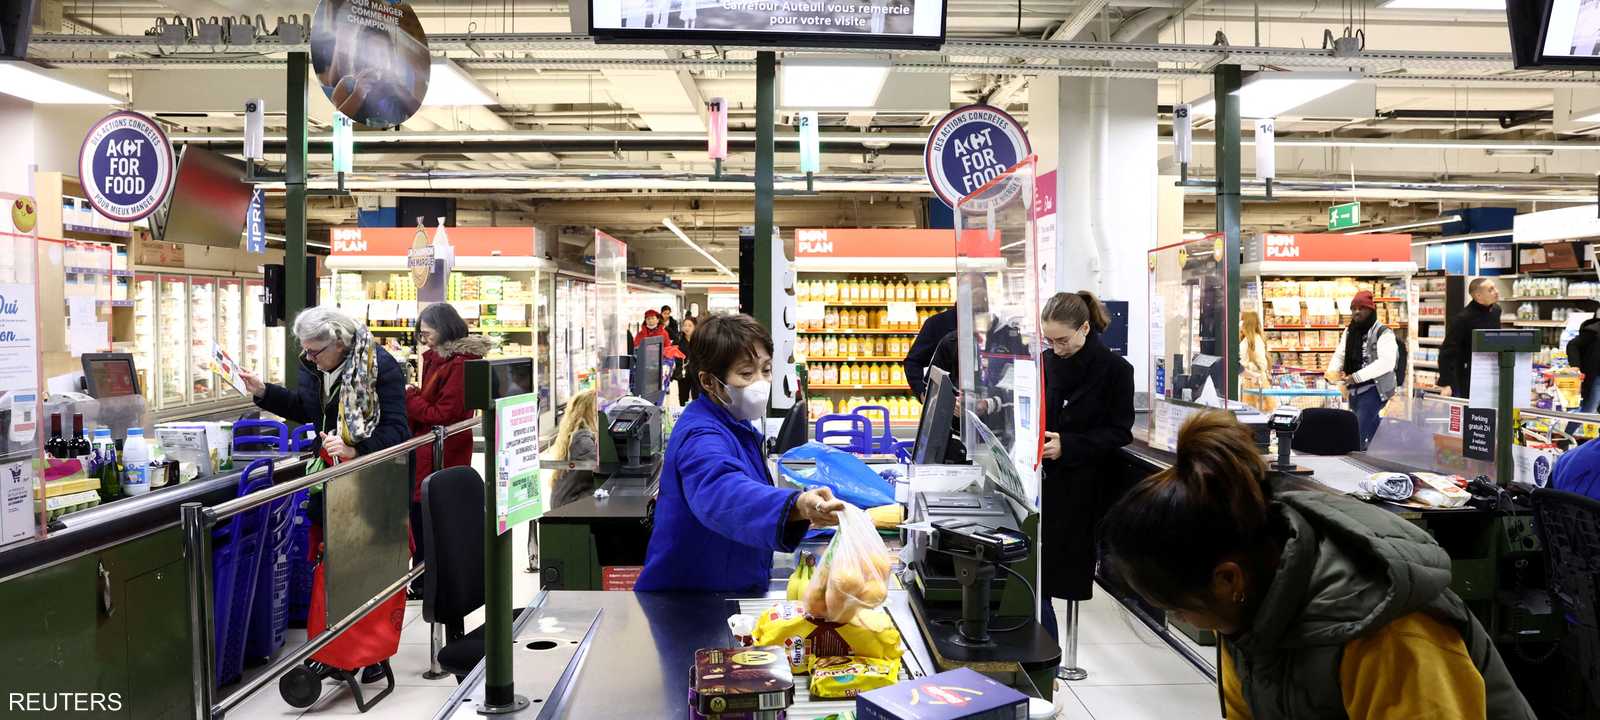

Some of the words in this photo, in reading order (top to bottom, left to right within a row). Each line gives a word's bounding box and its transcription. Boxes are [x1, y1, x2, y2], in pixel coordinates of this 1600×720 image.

[351, 5, 383, 20] COMME
[371, 1, 404, 17] MANGER
[722, 0, 778, 10] Carrefour
[782, 1, 825, 12] Auteuil
[828, 4, 855, 13] vous
[858, 3, 910, 15] remercie
[769, 15, 798, 26] pour
[800, 17, 832, 26] votre
[835, 16, 866, 27] visite
[1174, 108, 1188, 118] 13
[102, 119, 127, 133] ACTIONS
[933, 138, 945, 152] DES
[941, 113, 968, 138] ACTIONS
[1260, 124, 1273, 133] 14
[110, 157, 140, 176] FOR
[961, 148, 998, 174] FOR
[105, 176, 145, 195] FOOD
[962, 164, 1007, 194] FOOD
[95, 193, 109, 209] POUR
[110, 205, 130, 216] MIEUX
[131, 194, 155, 214] MANGER
[334, 241, 367, 251] PLAN
[799, 241, 832, 252] PLAN
[1267, 246, 1300, 256] PLAN
[1472, 415, 1488, 423] Parking
[793, 639, 803, 664] Harrys
